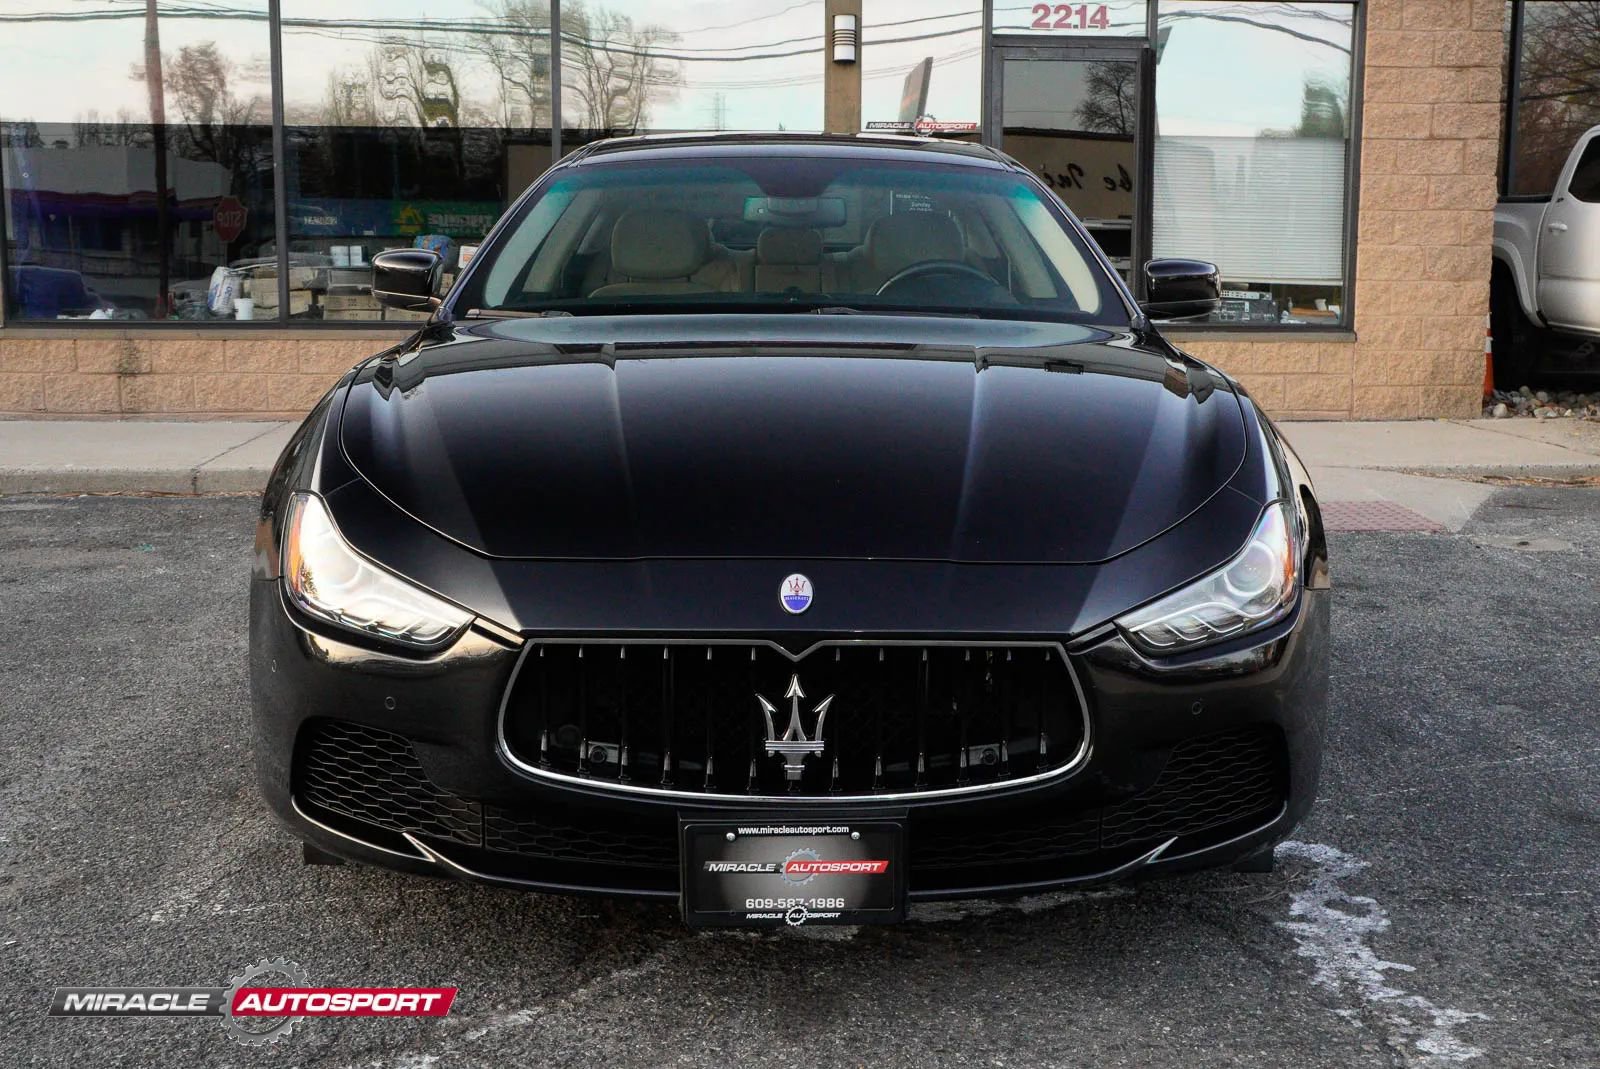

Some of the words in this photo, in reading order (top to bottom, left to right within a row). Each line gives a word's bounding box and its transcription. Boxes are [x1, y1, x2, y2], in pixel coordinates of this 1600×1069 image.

[1031, 3, 1110, 30] 2214
[917, 122, 974, 130] AUTOSPORT
[738, 825, 849, 835] www.miracleautosport.com
[708, 863, 776, 872] MIRACLE
[787, 862, 882, 872] AUTOSPORT
[746, 912, 783, 920] MIRACLE
